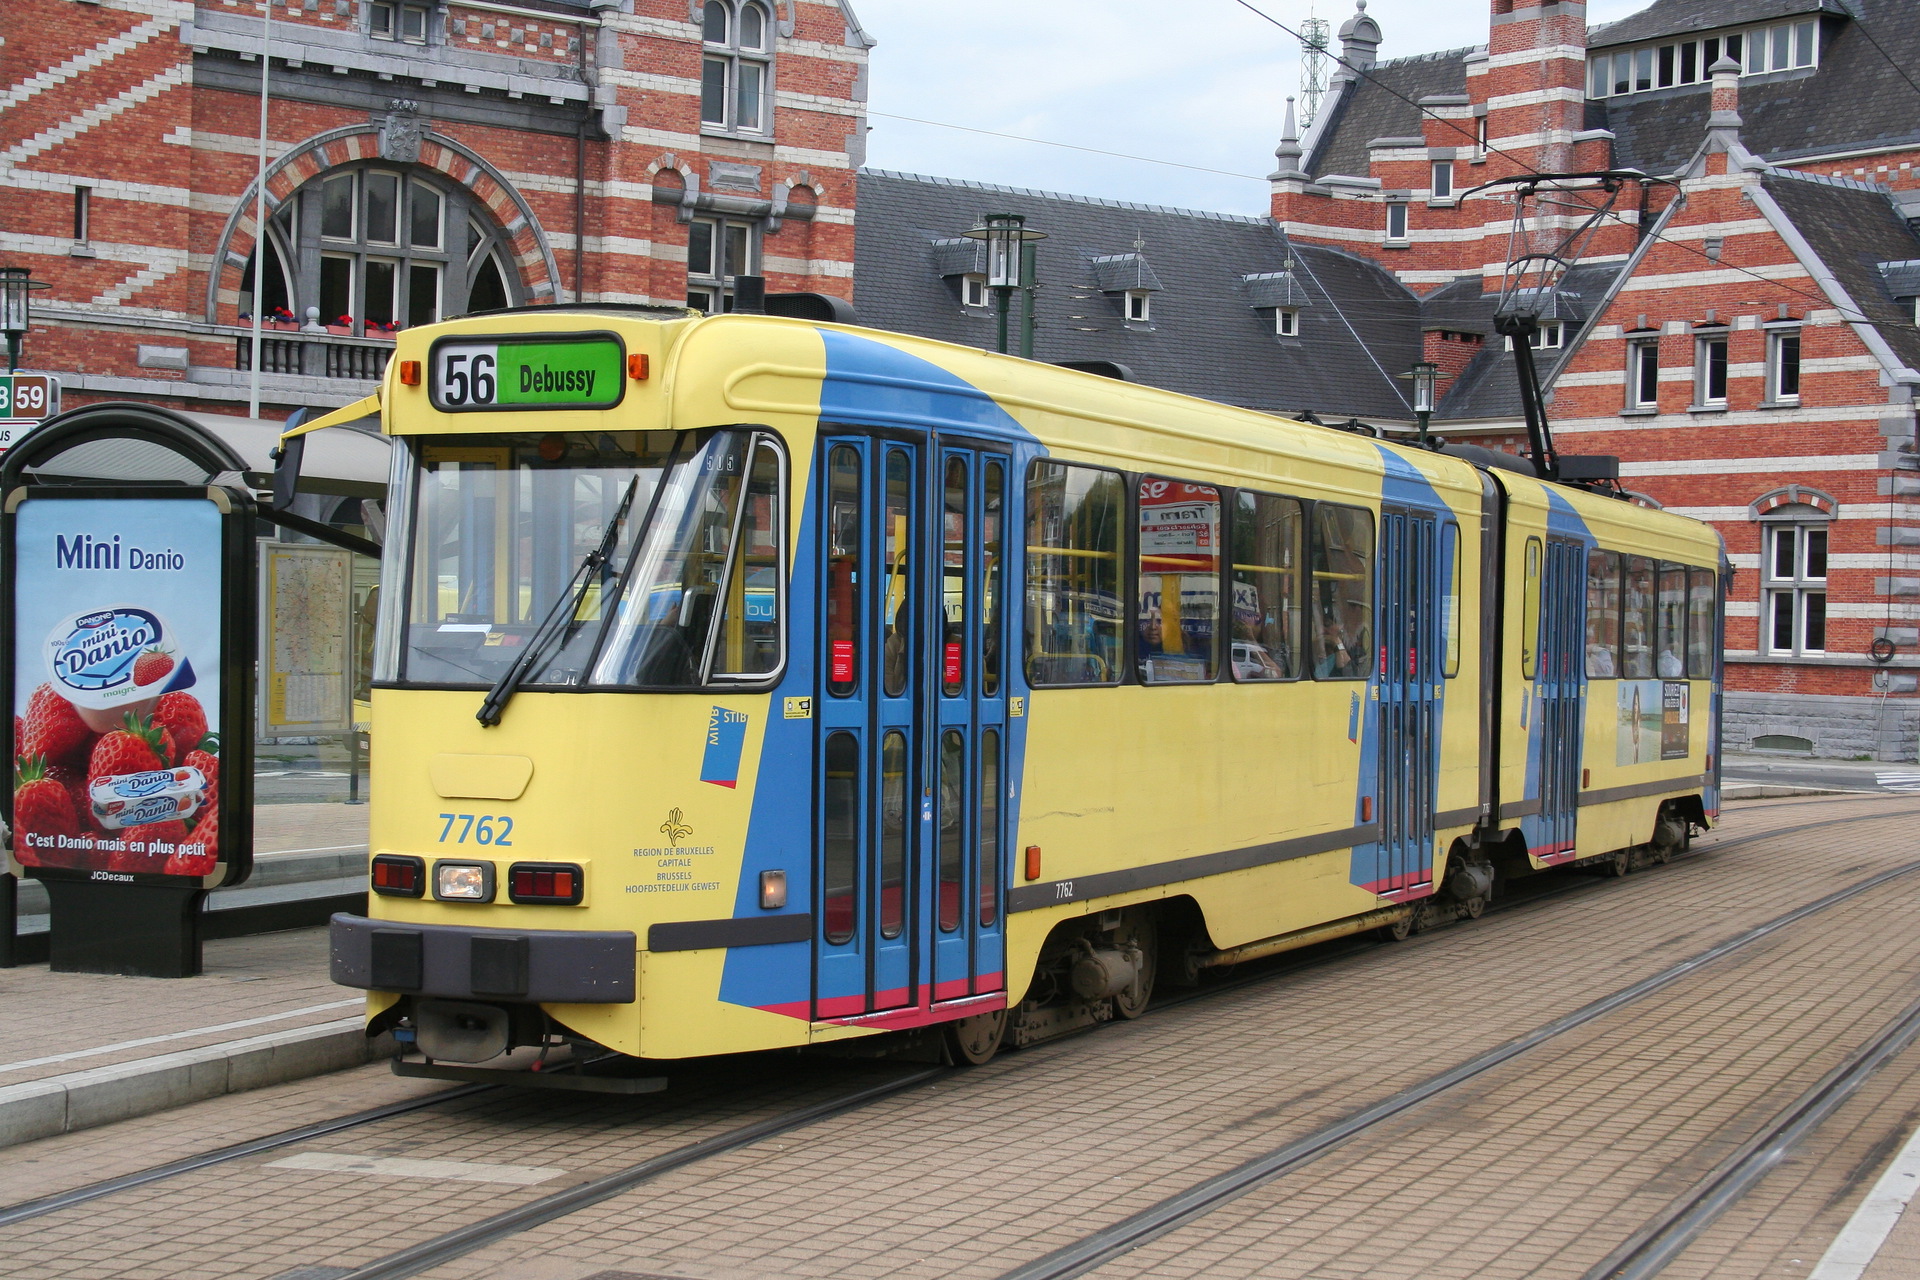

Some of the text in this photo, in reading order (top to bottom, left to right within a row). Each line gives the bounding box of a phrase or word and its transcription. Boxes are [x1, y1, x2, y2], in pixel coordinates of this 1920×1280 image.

[445, 354, 495, 405] 56
[520, 364, 596, 397] Debussy
[16, 386, 44, 409] 59
[57, 534, 184, 570] Mini Danio
[82, 624, 117, 649] mini
[63, 628, 146, 673] Danio
[723, 711, 747, 723] STIB
[108, 777, 128, 787] mini
[129, 772, 170, 789] Danio
[115, 806, 135, 819] mini
[134, 799, 175, 820] Danio
[438, 813, 514, 847] 7762
[25, 832, 206, 858] C'est Danio mais en plus petit
[633, 846, 714, 857] REGION DE BRUXELLES
[657, 858, 691, 867] CAPITALE
[91, 871, 134, 882] JCDecaux
[656, 871, 692, 881] BRUSSELS
[625, 882, 720, 893] HOOFDSTEDELIJK GEWEST
[1055, 881, 1073, 899] 7762
